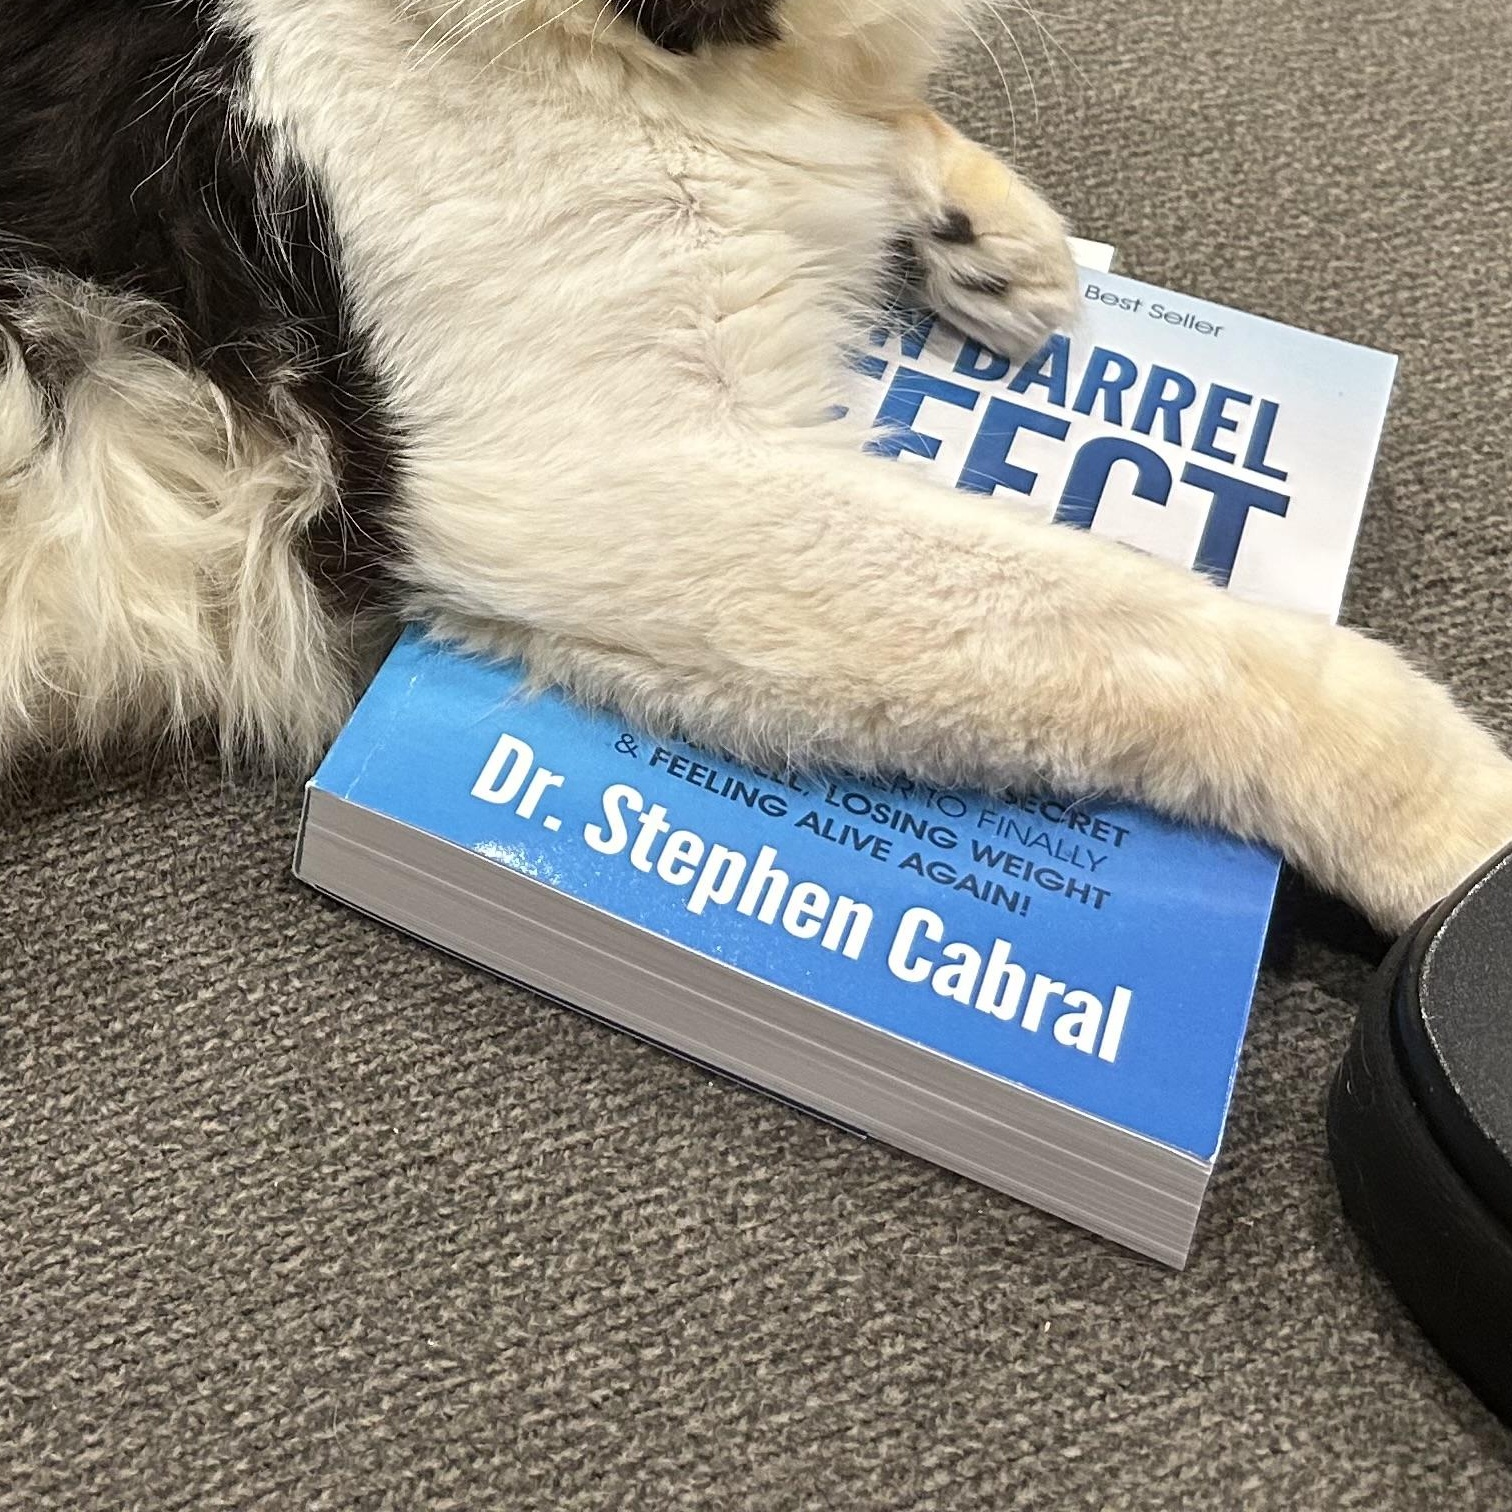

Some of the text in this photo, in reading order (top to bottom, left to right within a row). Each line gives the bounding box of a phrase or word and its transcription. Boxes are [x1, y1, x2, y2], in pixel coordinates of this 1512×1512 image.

[1083, 284, 1226, 338] Best Seller
[614, 733, 1031, 917] & FEELING ALIVE AGAIN!
[825, 782, 958, 849] LOSING
[971, 839, 1111, 910] WEIGHT
[977, 809, 1108, 873] FINALLY
[469, 732, 1133, 1064] Dr. Stephen Cabral
